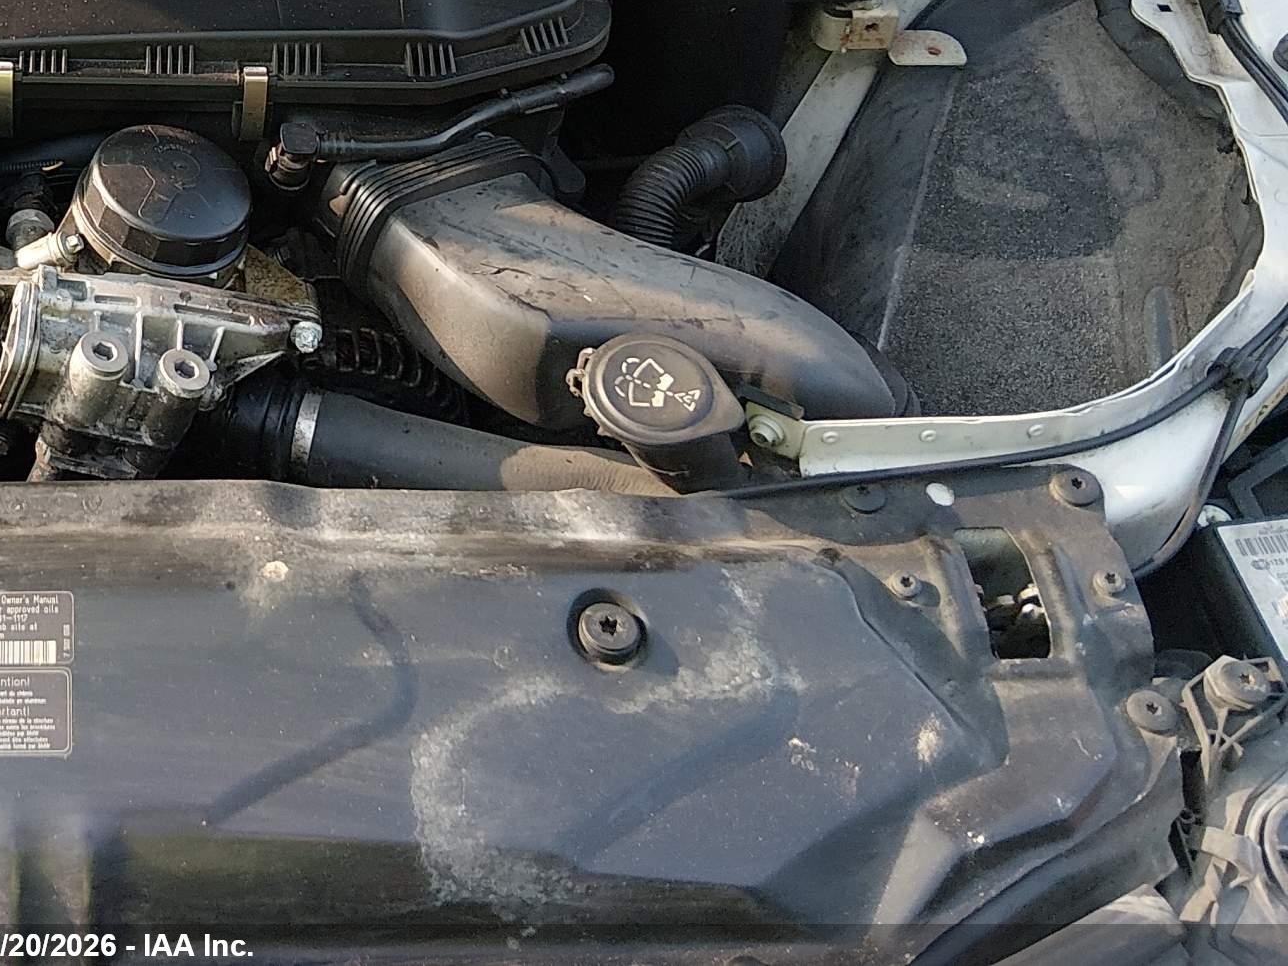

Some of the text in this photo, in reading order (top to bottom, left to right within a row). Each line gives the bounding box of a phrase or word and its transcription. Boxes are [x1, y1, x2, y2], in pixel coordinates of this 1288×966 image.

[1, 595, 29, 604] Owner's
[33, 595, 58, 604] Manual
[6, 604, 39, 615] approved
[44, 604, 58, 613] oils
